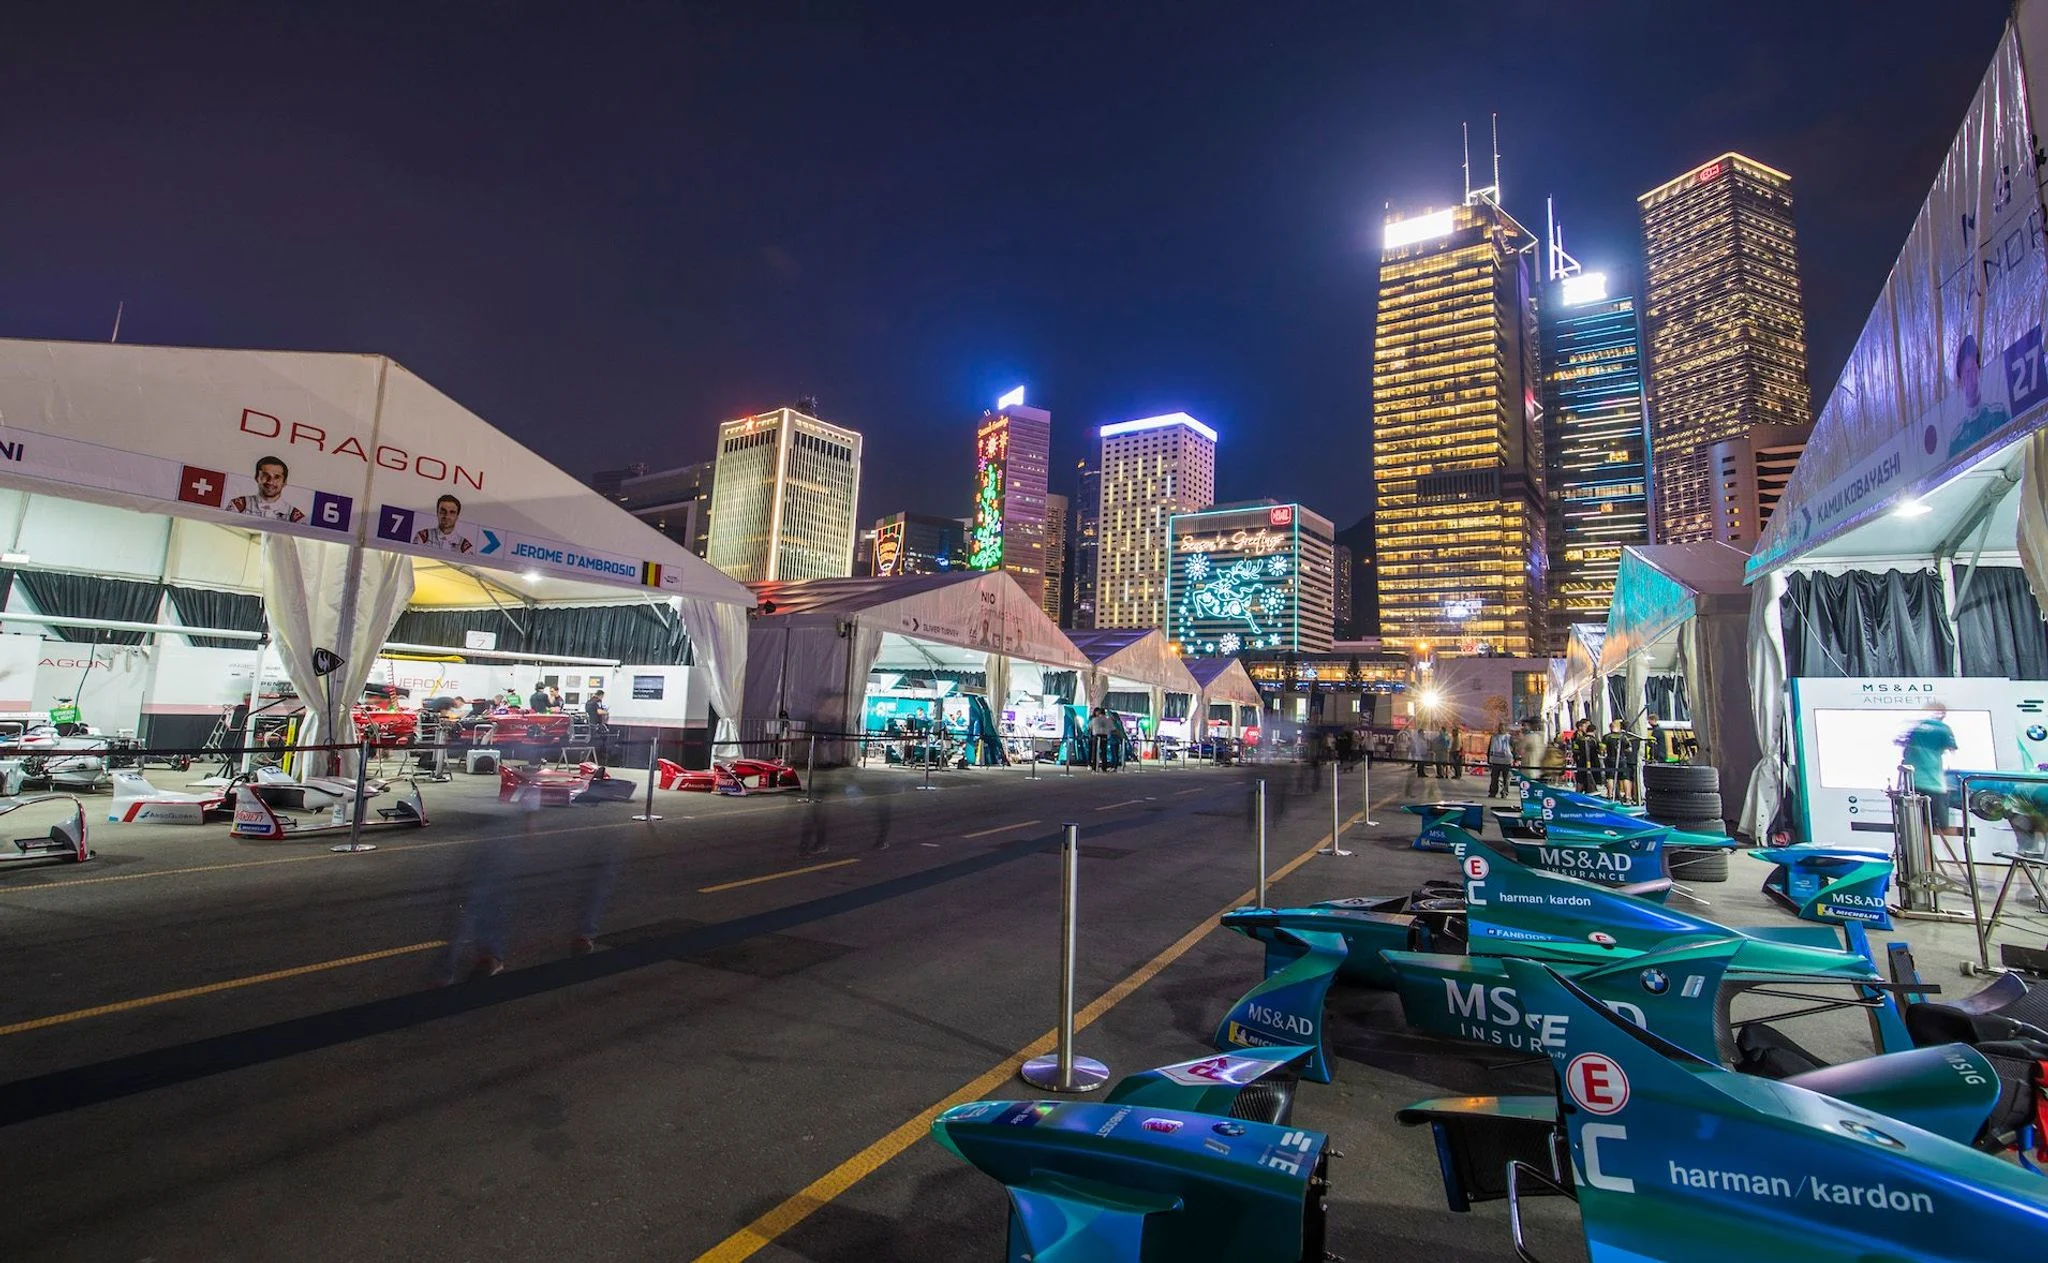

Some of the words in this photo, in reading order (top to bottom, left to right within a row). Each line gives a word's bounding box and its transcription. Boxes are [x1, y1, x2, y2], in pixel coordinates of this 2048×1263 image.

[2011, 345, 2040, 402] 27
[240, 408, 484, 491] DRAGON
[1817, 491, 1844, 525] KAMUI
[1843, 451, 1901, 508] KOBAYASHI
[322, 501, 340, 524] 6
[390, 513, 405, 534] 7
[1181, 535, 1228, 551] Season's
[1231, 528, 1286, 554] Greetings
[511, 542, 563, 564] JEROME
[566, 553, 636, 578] D'AMBROSIO
[981, 592, 996, 604] NIO
[1863, 696, 1937, 704] ANDRETTI
[1542, 808, 1554, 820] B
[1471, 860, 1482, 875] E
[1538, 847, 1632, 872] MS&AD
[1832, 893, 1885, 908] MS&AD
[1836, 910, 1880, 920] MICHELIN
[1248, 1002, 1314, 1036] MS&AD
[1581, 1062, 1613, 1105] E
